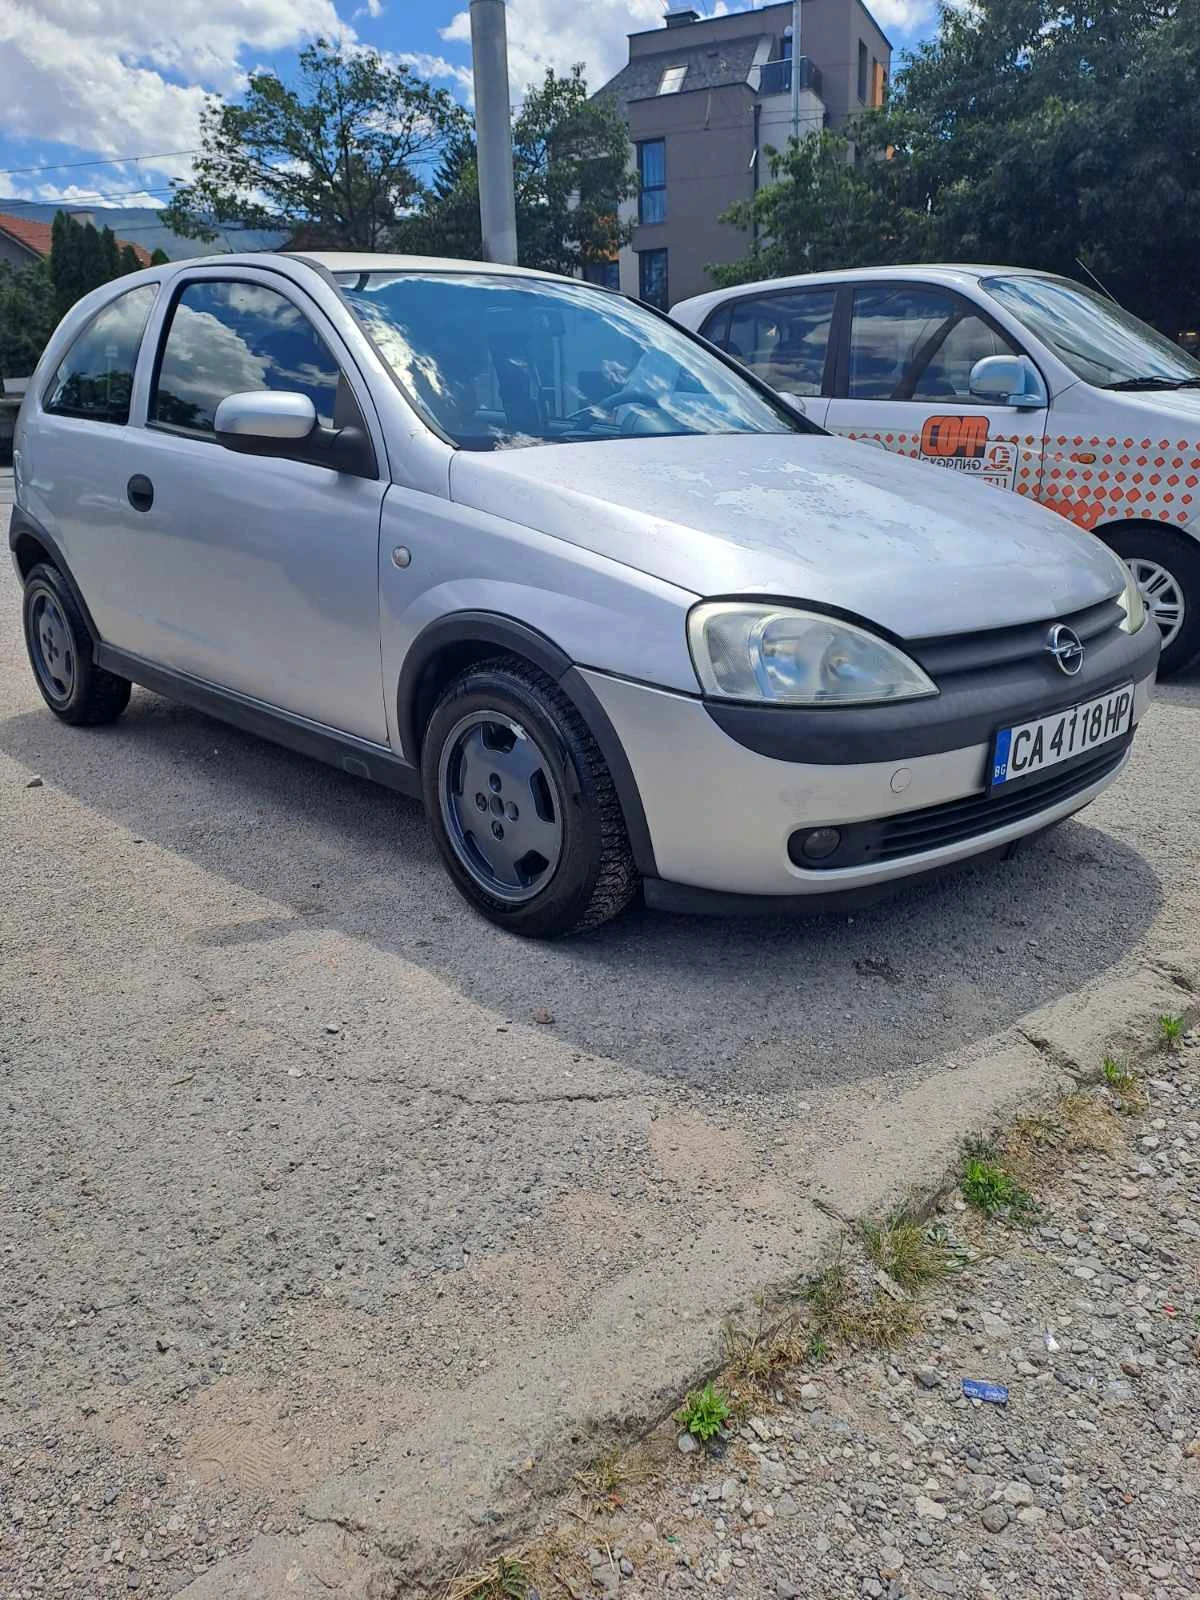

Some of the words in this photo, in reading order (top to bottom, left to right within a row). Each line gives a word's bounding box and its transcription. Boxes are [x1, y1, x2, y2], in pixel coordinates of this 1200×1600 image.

[1012, 726, 1043, 772] CA
[1050, 703, 1103, 757] 4118
[1103, 692, 1130, 737] HP
[994, 763, 1006, 777] BG
